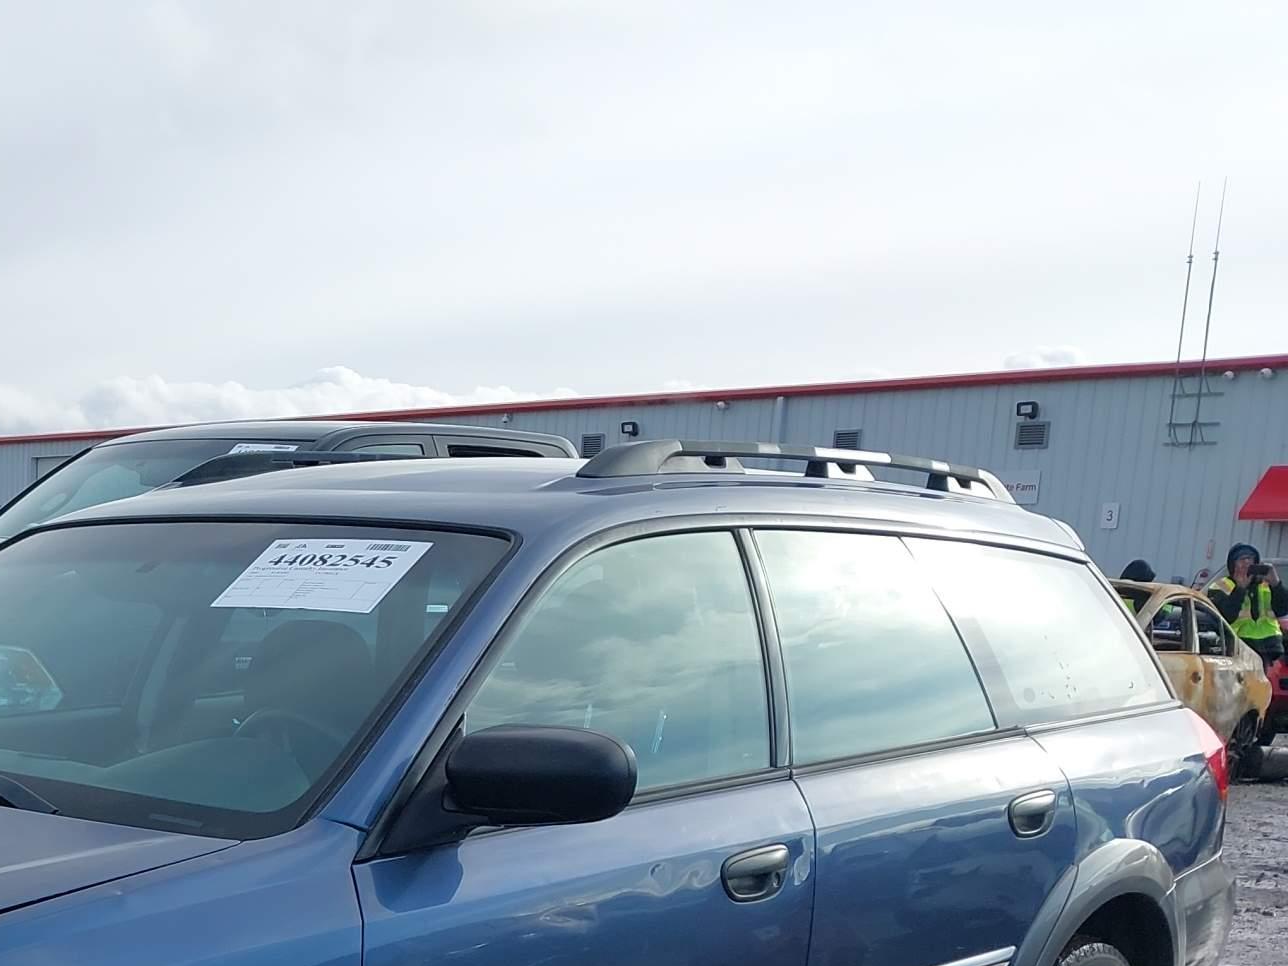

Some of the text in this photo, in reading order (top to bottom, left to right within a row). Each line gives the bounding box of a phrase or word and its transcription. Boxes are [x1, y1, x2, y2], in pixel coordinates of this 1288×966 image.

[1015, 482, 1037, 491] Farm
[1106, 510, 1114, 522] 3
[268, 553, 398, 569] 44082545
